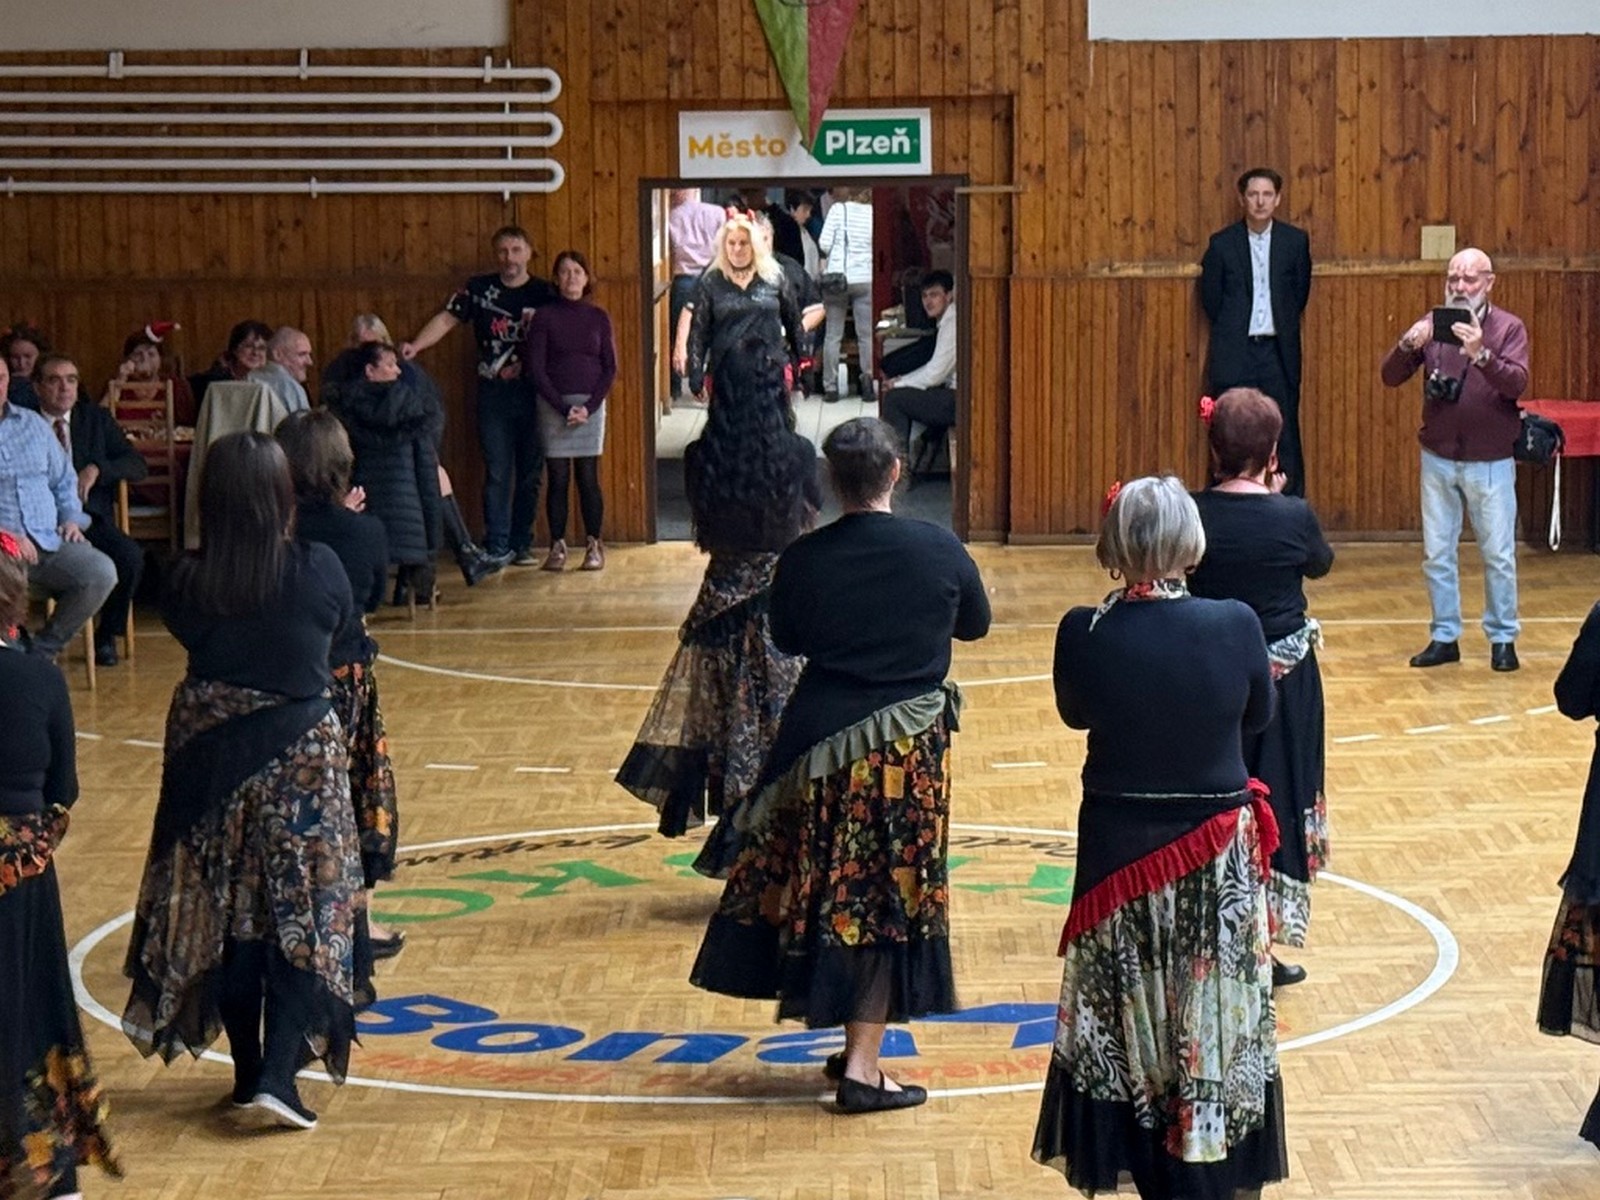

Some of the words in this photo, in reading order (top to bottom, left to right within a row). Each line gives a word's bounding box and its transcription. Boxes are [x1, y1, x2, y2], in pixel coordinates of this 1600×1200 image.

[688, 132, 787, 159] Město
[825, 127, 911, 156] Plzeň
[352, 993, 920, 1066] Bona
